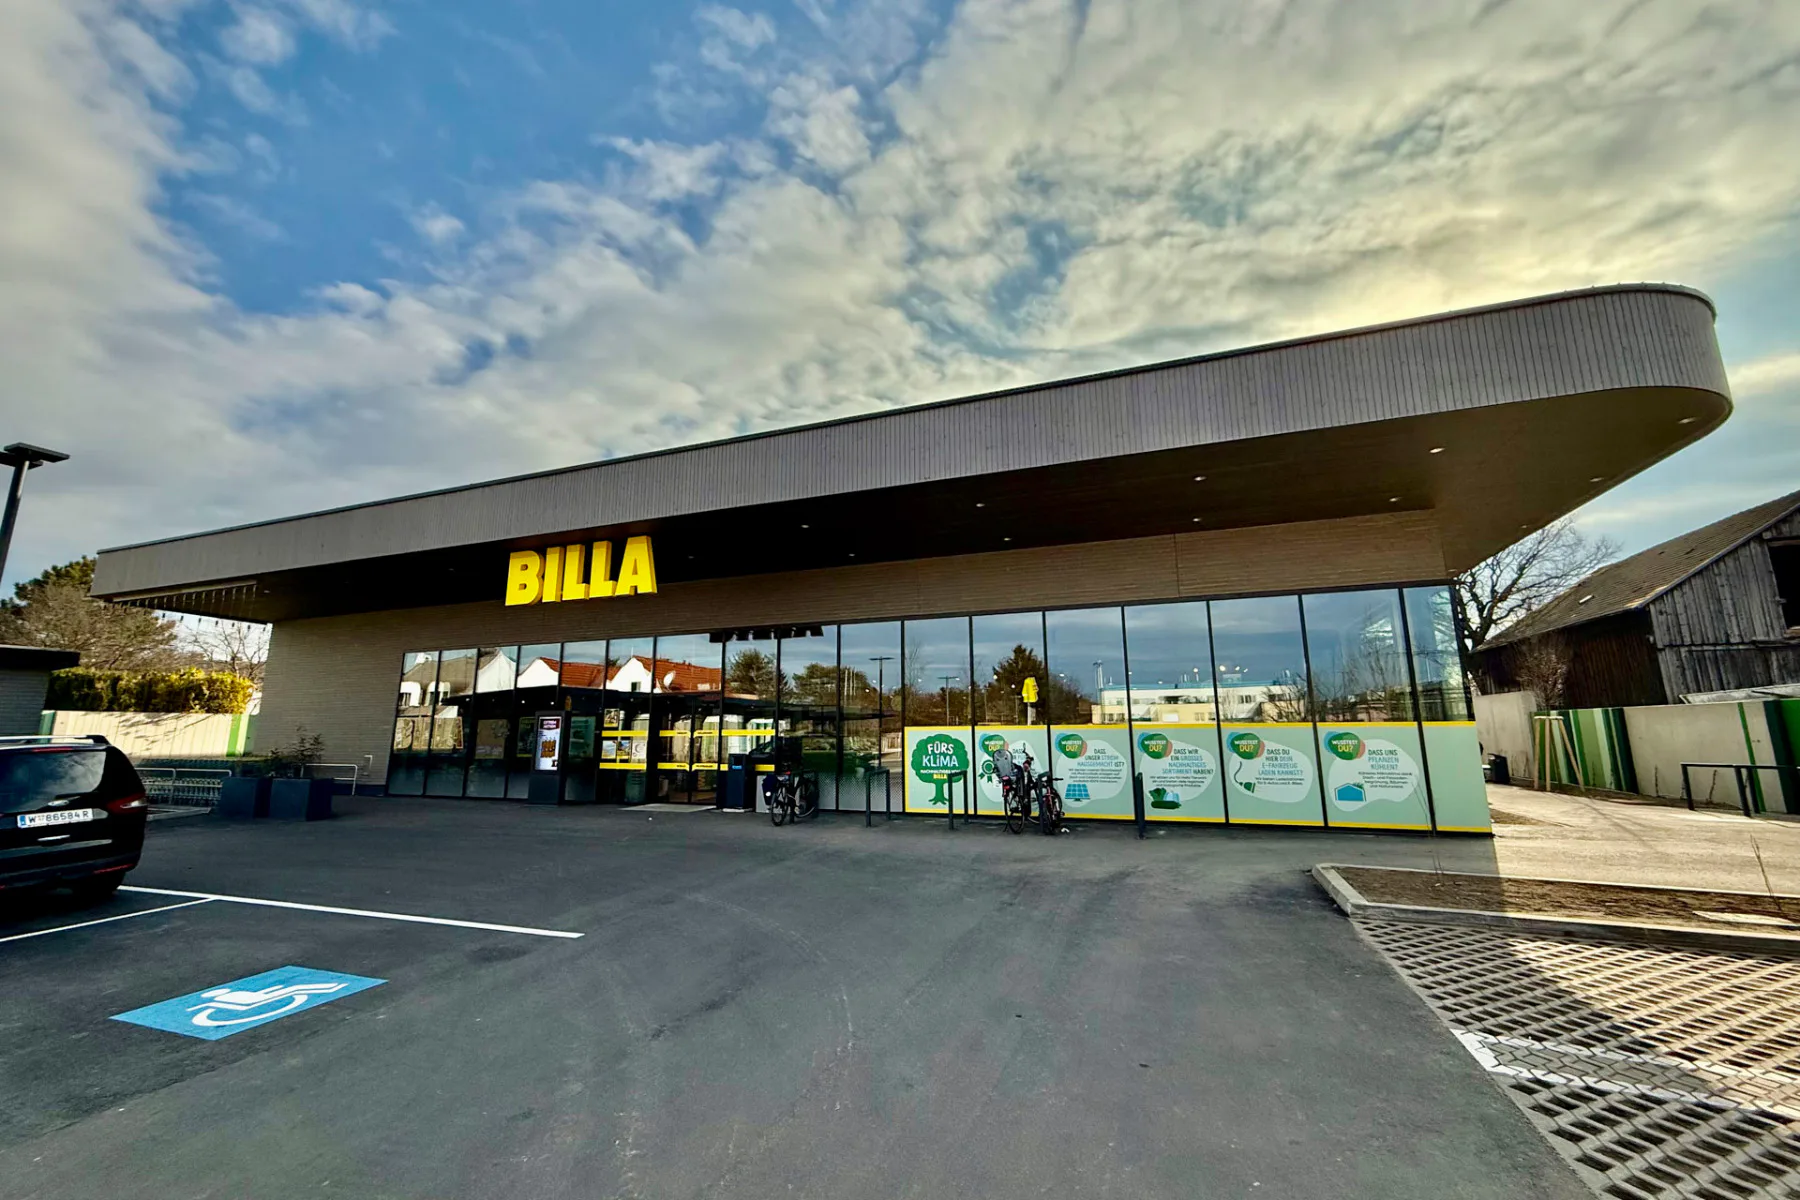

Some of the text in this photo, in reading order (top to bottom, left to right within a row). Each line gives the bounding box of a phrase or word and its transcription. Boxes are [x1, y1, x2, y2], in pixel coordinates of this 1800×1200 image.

[505, 536, 658, 606] BILLA
[927, 741, 955, 755] FÜRS
[1370, 763, 1398, 771] KÜHLEN?
[29, 810, 89, 824] W 86584 R
